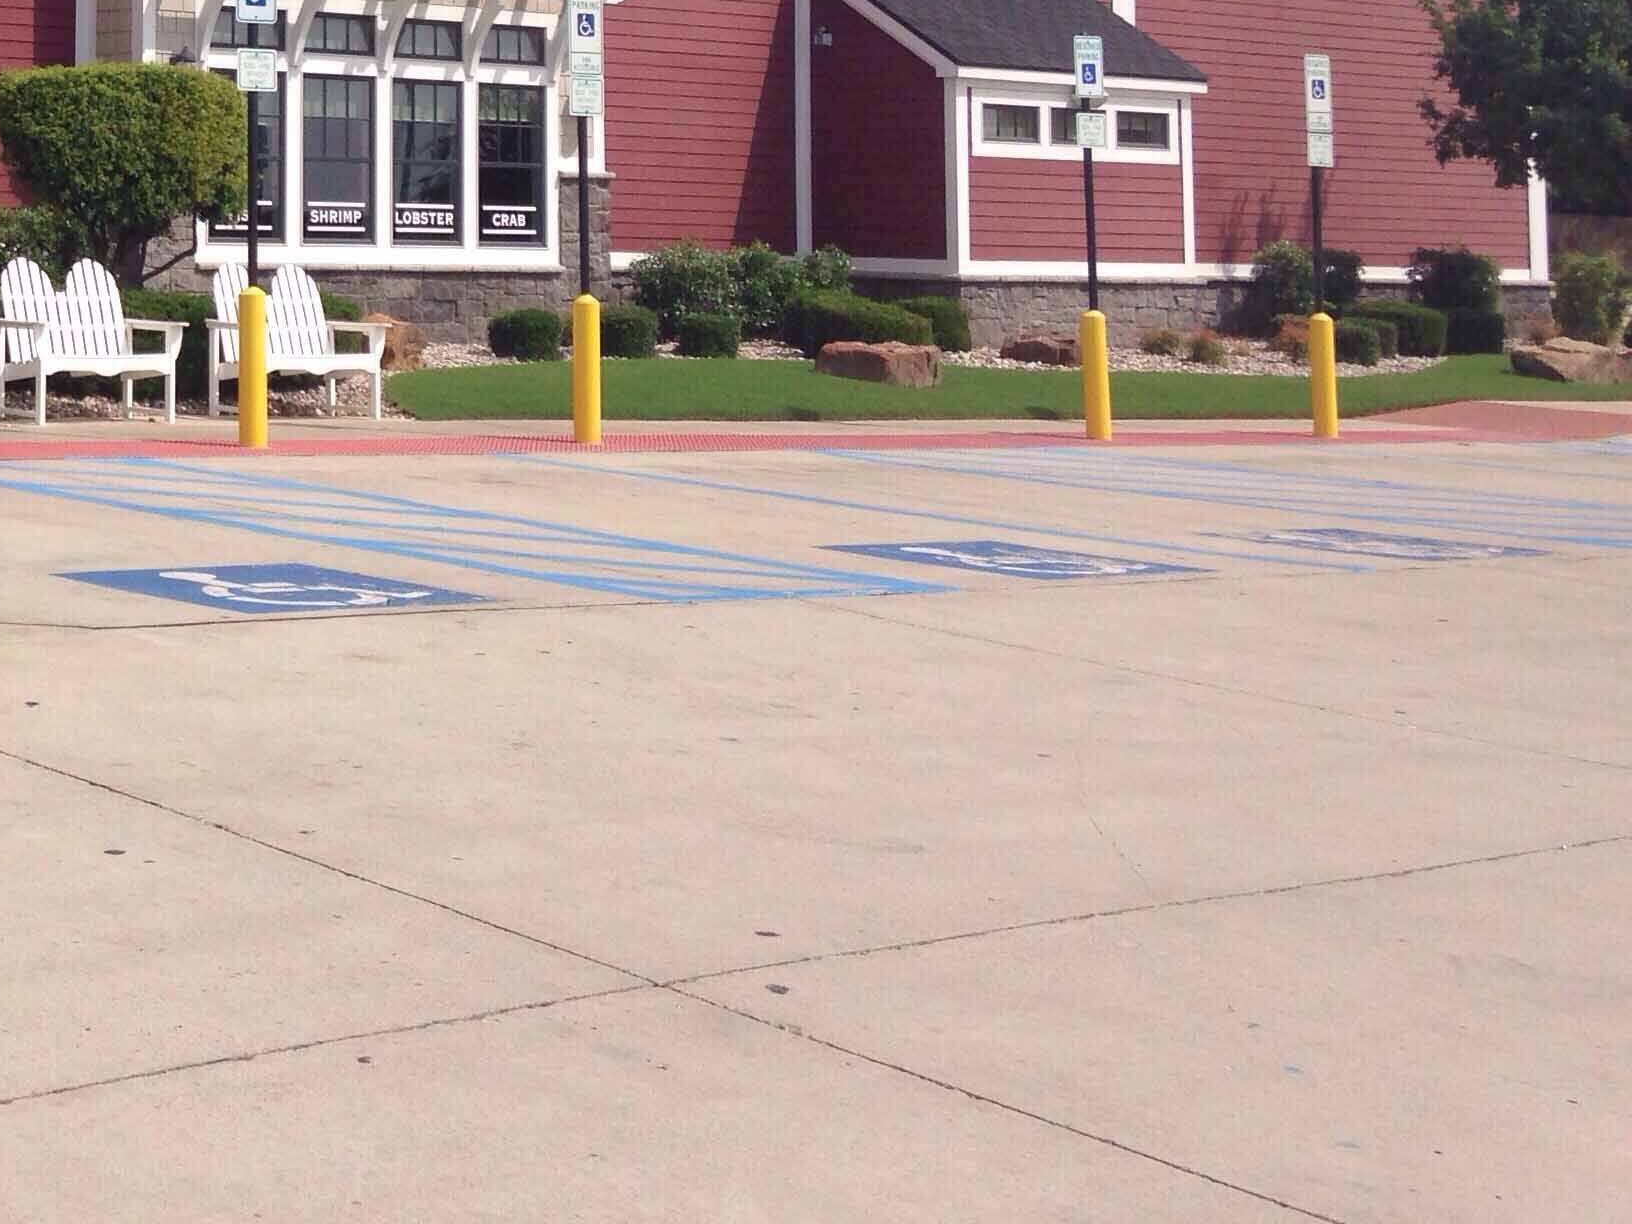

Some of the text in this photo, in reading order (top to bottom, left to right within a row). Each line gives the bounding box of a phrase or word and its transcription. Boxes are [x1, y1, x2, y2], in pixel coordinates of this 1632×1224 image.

[310, 209, 362, 224] SHRIMP
[395, 211, 454, 226] LOBSTER
[492, 213, 526, 227] CRAB
